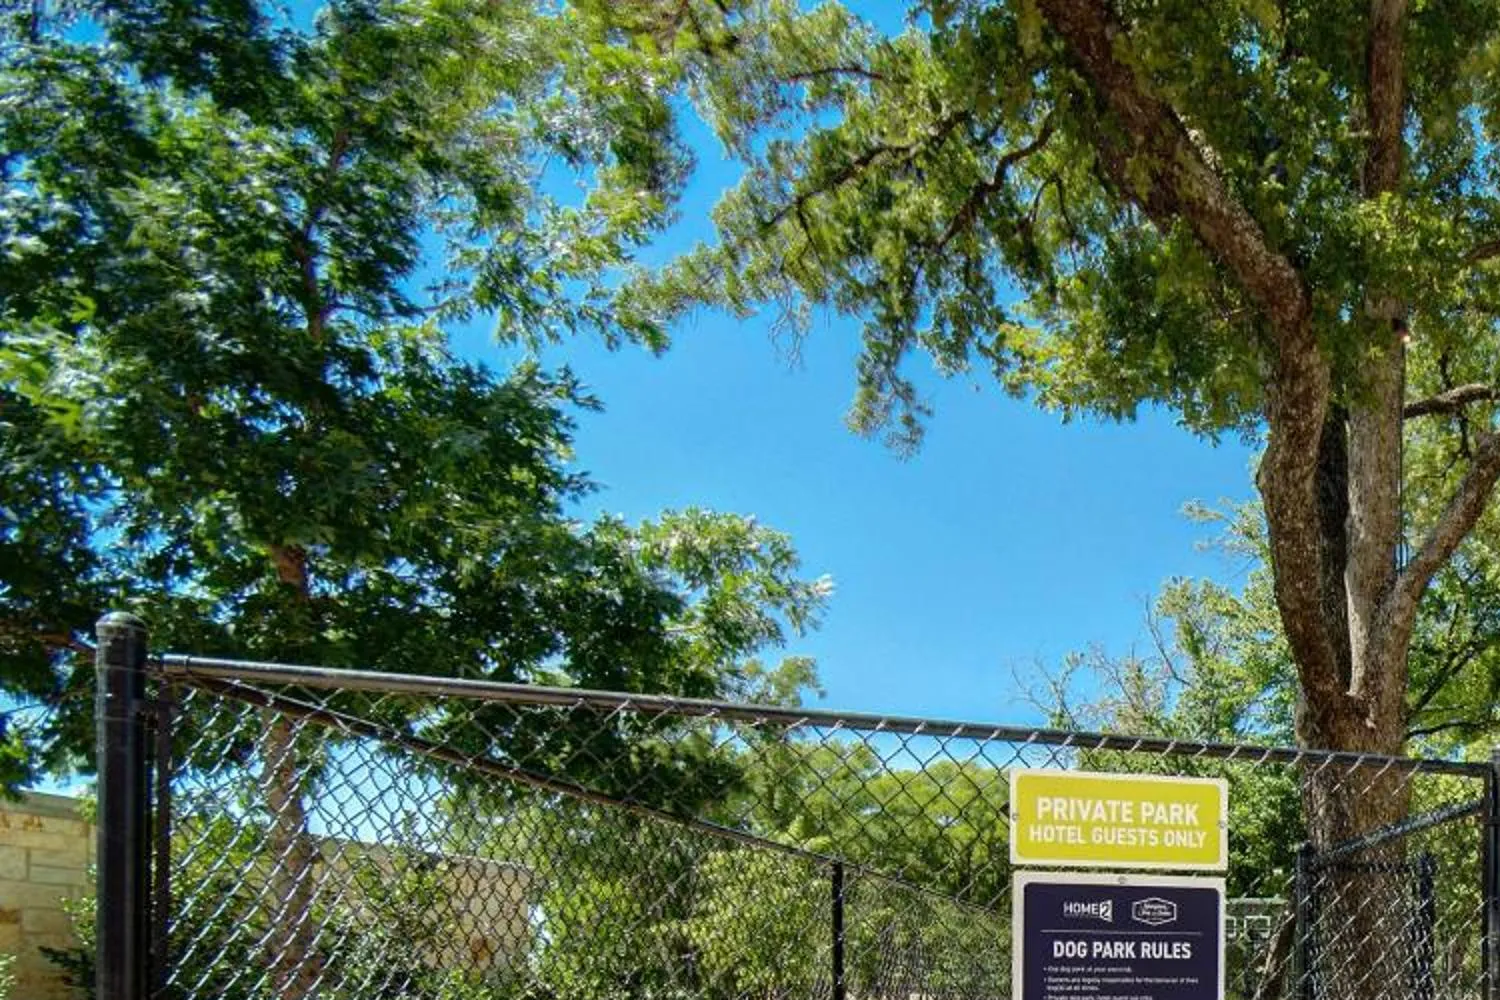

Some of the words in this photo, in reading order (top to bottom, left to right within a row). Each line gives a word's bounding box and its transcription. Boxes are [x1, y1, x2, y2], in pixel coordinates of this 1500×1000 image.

[1036, 797, 1134, 823] PRIVATE
[1141, 801, 1200, 827] PARK
[1029, 824, 1087, 844] HOTEL
[1091, 827, 1159, 847] GUESTS
[1163, 830, 1207, 849] ONLY
[1053, 941, 1087, 958] DOG
[1093, 941, 1137, 959] PARK
[1141, 942, 1192, 960] RULES
